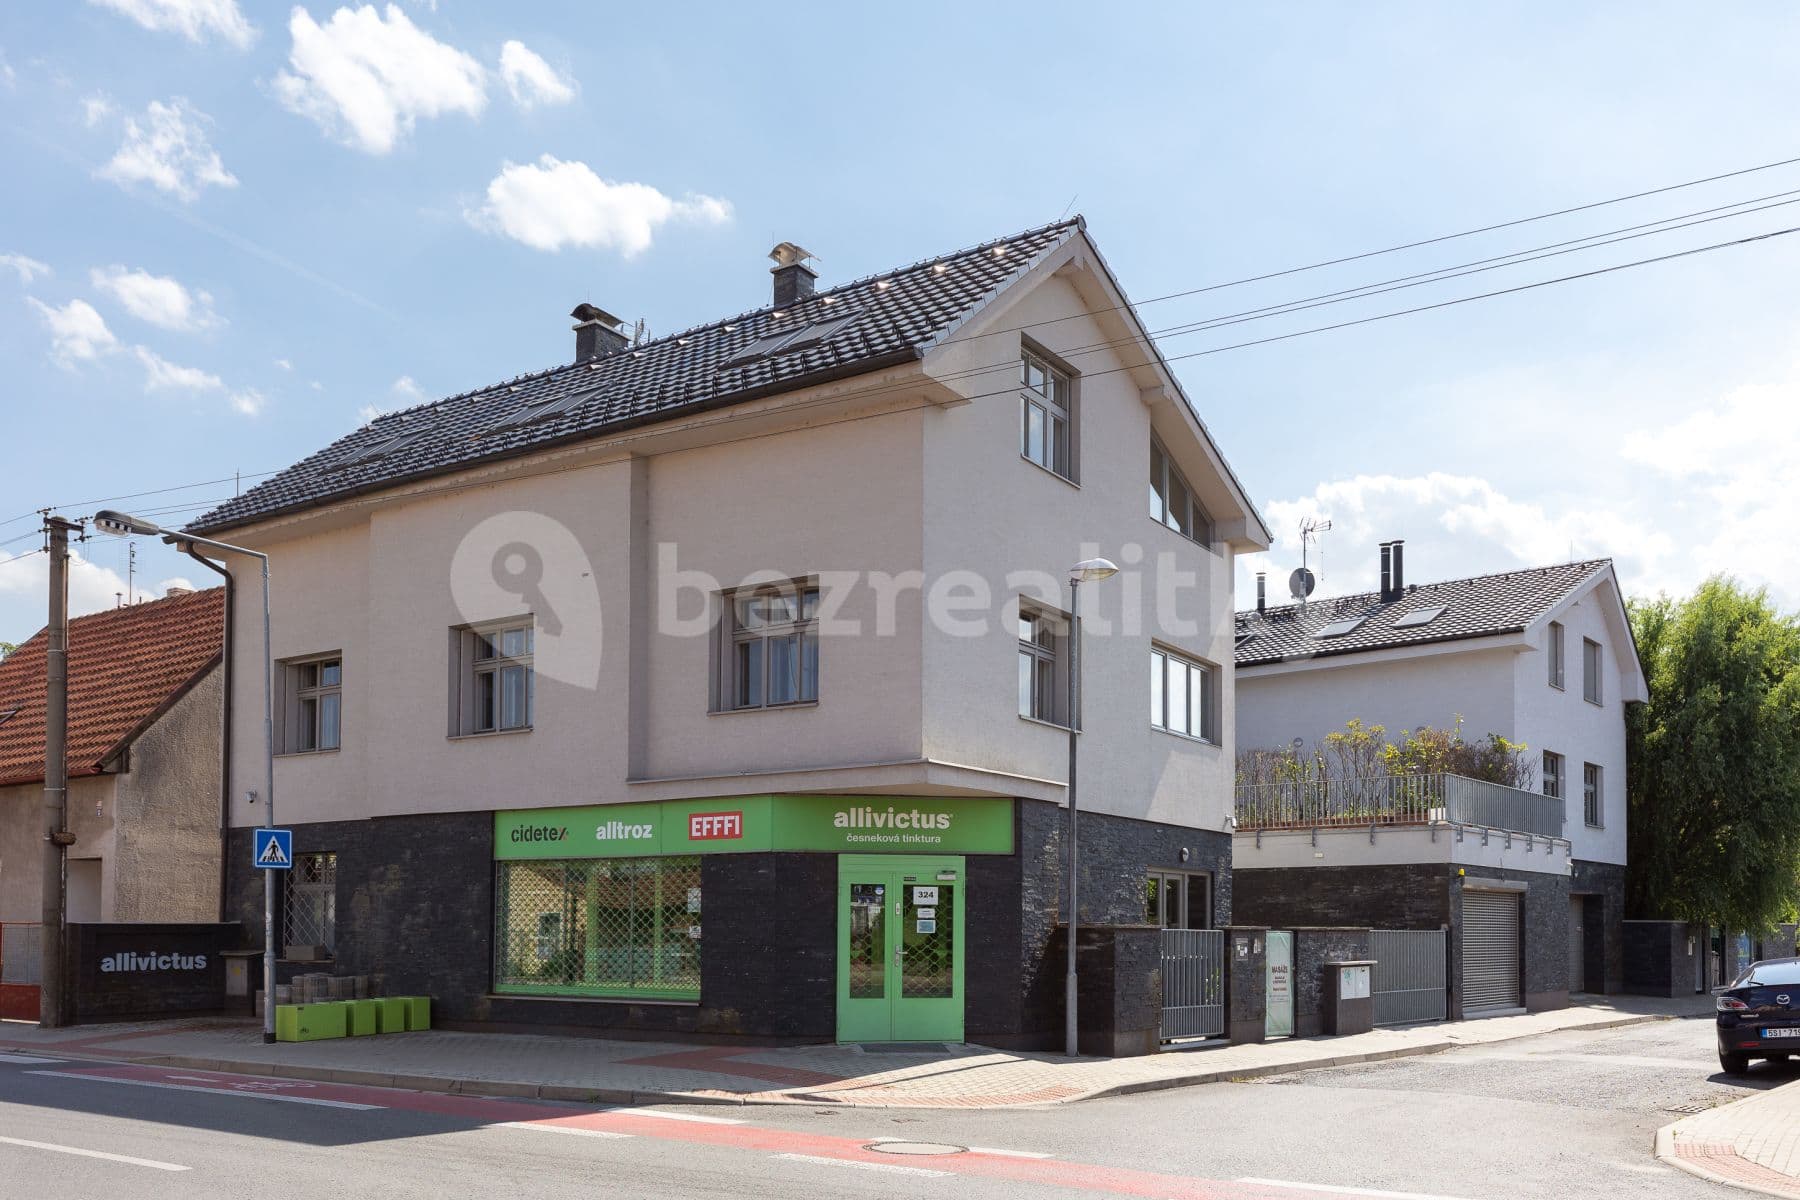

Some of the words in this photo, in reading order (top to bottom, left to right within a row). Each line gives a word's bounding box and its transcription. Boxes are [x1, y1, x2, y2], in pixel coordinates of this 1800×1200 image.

[691, 815, 740, 837] EFFFI
[833, 806, 951, 829] allivictus
[511, 824, 568, 842] cidetex
[595, 821, 653, 840] alltroz
[846, 832, 900, 843] česneková
[902, 833, 942, 843] tinktura
[917, 891, 934, 899] 324
[100, 951, 208, 972] allivictus
